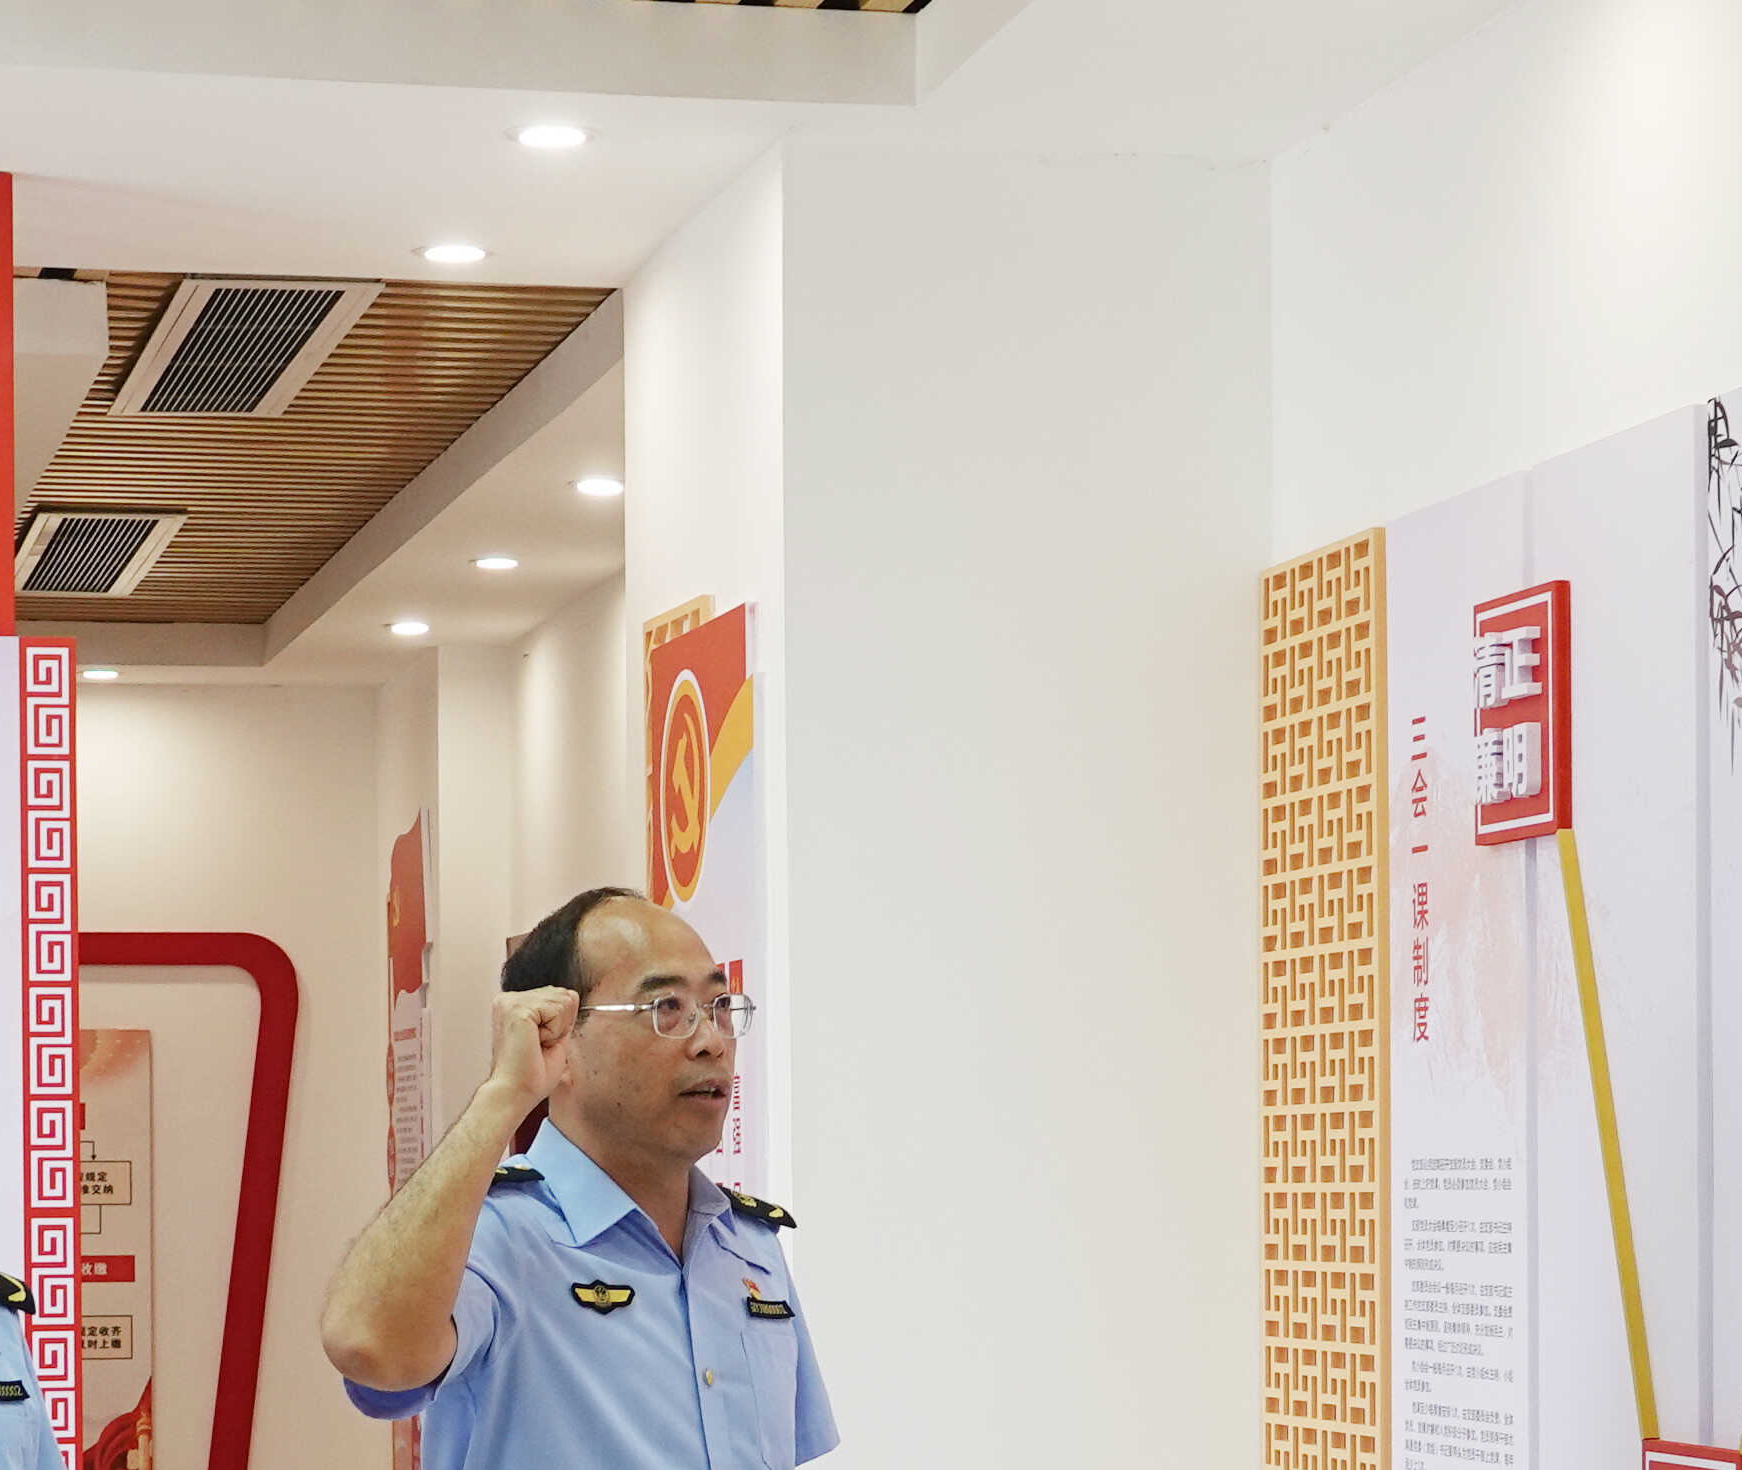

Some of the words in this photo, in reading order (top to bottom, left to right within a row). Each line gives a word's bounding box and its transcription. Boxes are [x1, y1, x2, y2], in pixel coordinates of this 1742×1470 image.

[1411, 715, 1430, 1043] 三会一课制度
